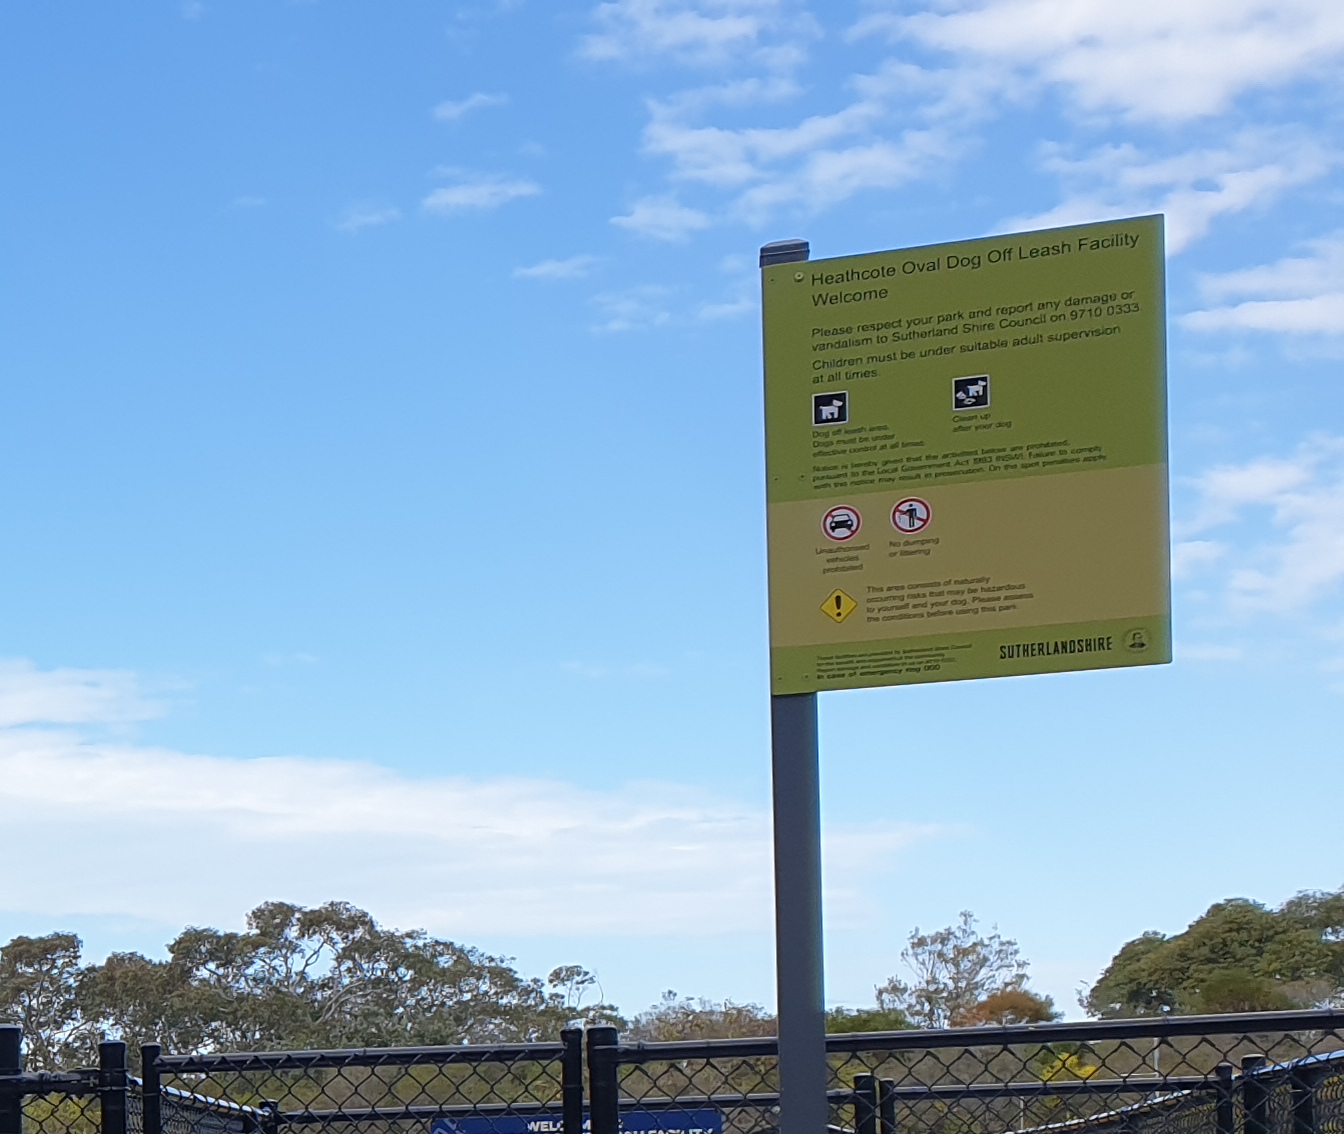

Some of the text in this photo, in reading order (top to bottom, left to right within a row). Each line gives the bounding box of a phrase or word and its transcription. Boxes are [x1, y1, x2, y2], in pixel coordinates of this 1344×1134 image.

[812, 233, 1139, 286] Heathcote Oval Dog Off Leash Facility
[812, 289, 888, 306] Welcome
[812, 291, 1135, 337] Please respect your park and report any damage or
[812, 303, 1139, 351] vandalism to Sutherland Shire Council on 9710 0333
[813, 325, 1120, 370] Children must be under suitable adult supervision
[813, 368, 879, 384] at all times.
[1000, 636, 1112, 659] SUTHERLANDSHIRE
